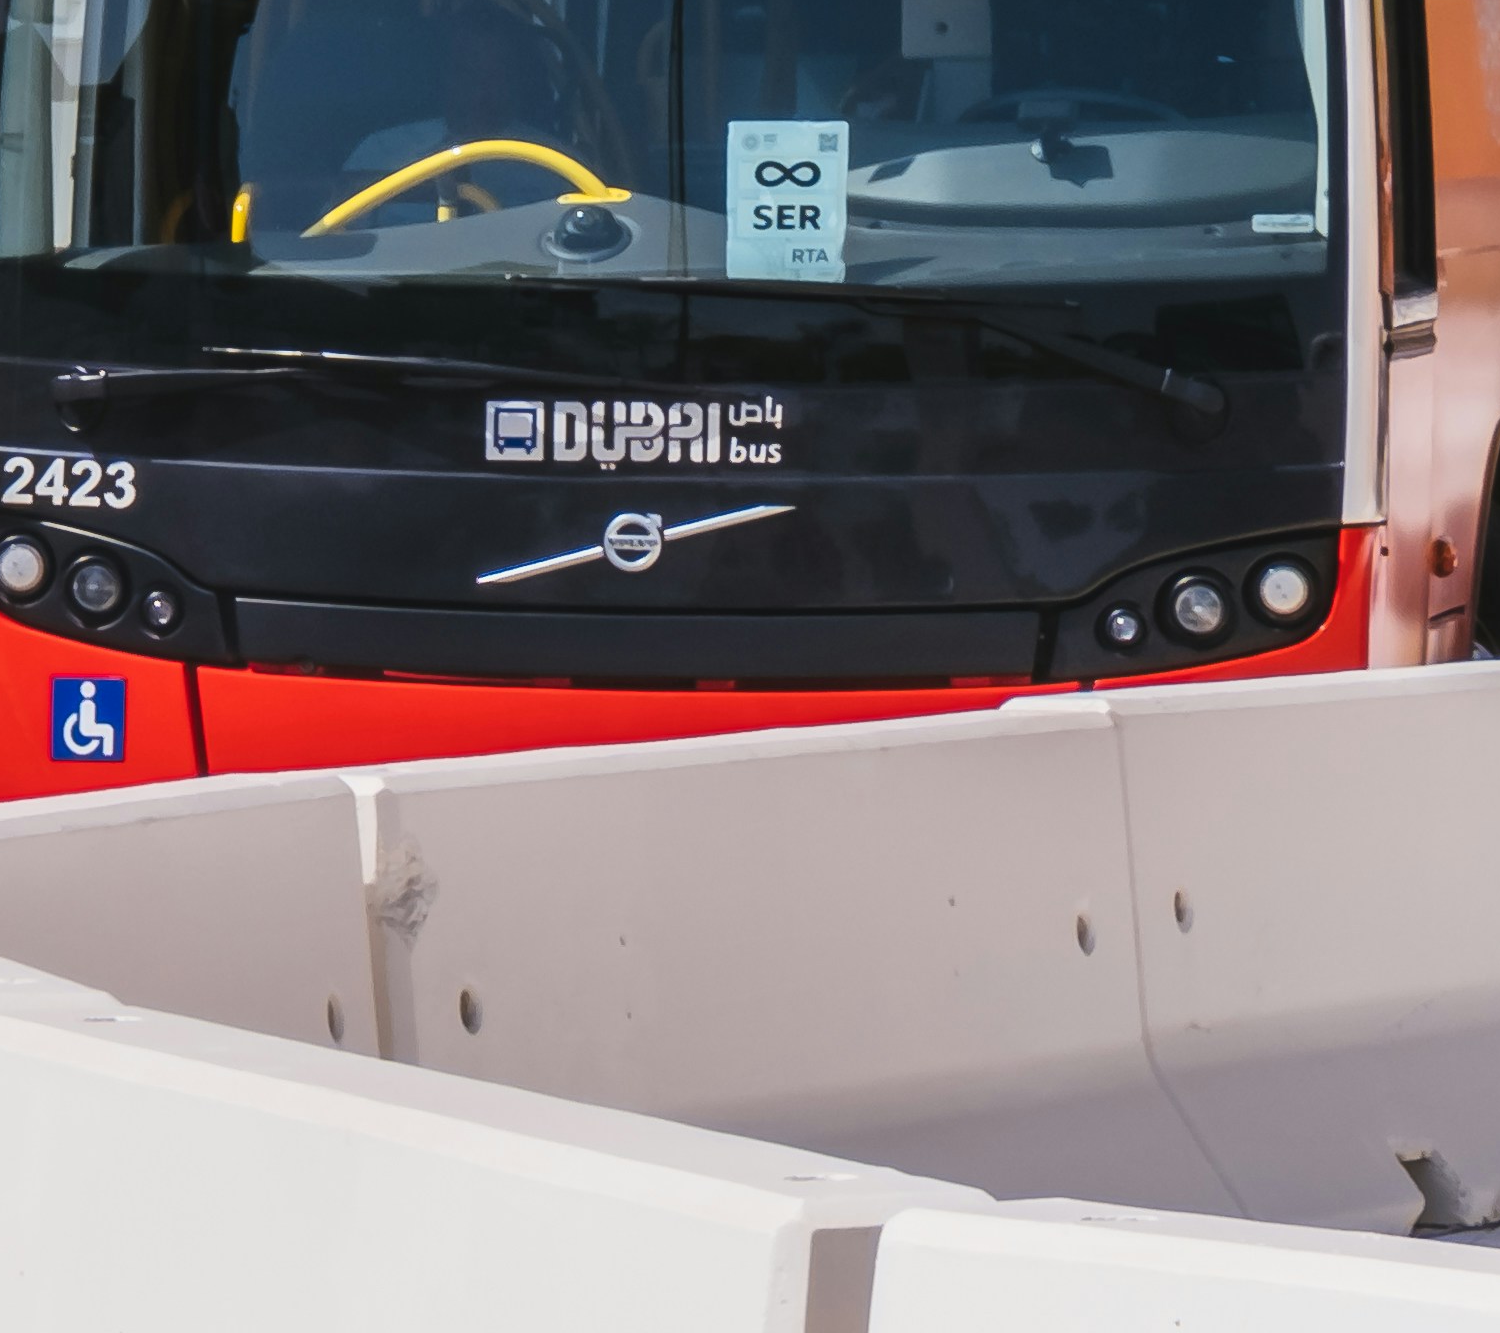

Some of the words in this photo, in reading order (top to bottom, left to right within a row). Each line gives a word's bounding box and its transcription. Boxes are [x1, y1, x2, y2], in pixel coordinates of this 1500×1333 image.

[753, 204, 822, 231] SER
[792, 248, 829, 264] RTA
[728, 395, 784, 429] باص
[553, 400, 721, 464] DUBAI
[728, 436, 783, 464] bus
[1, 456, 137, 509] 2423
